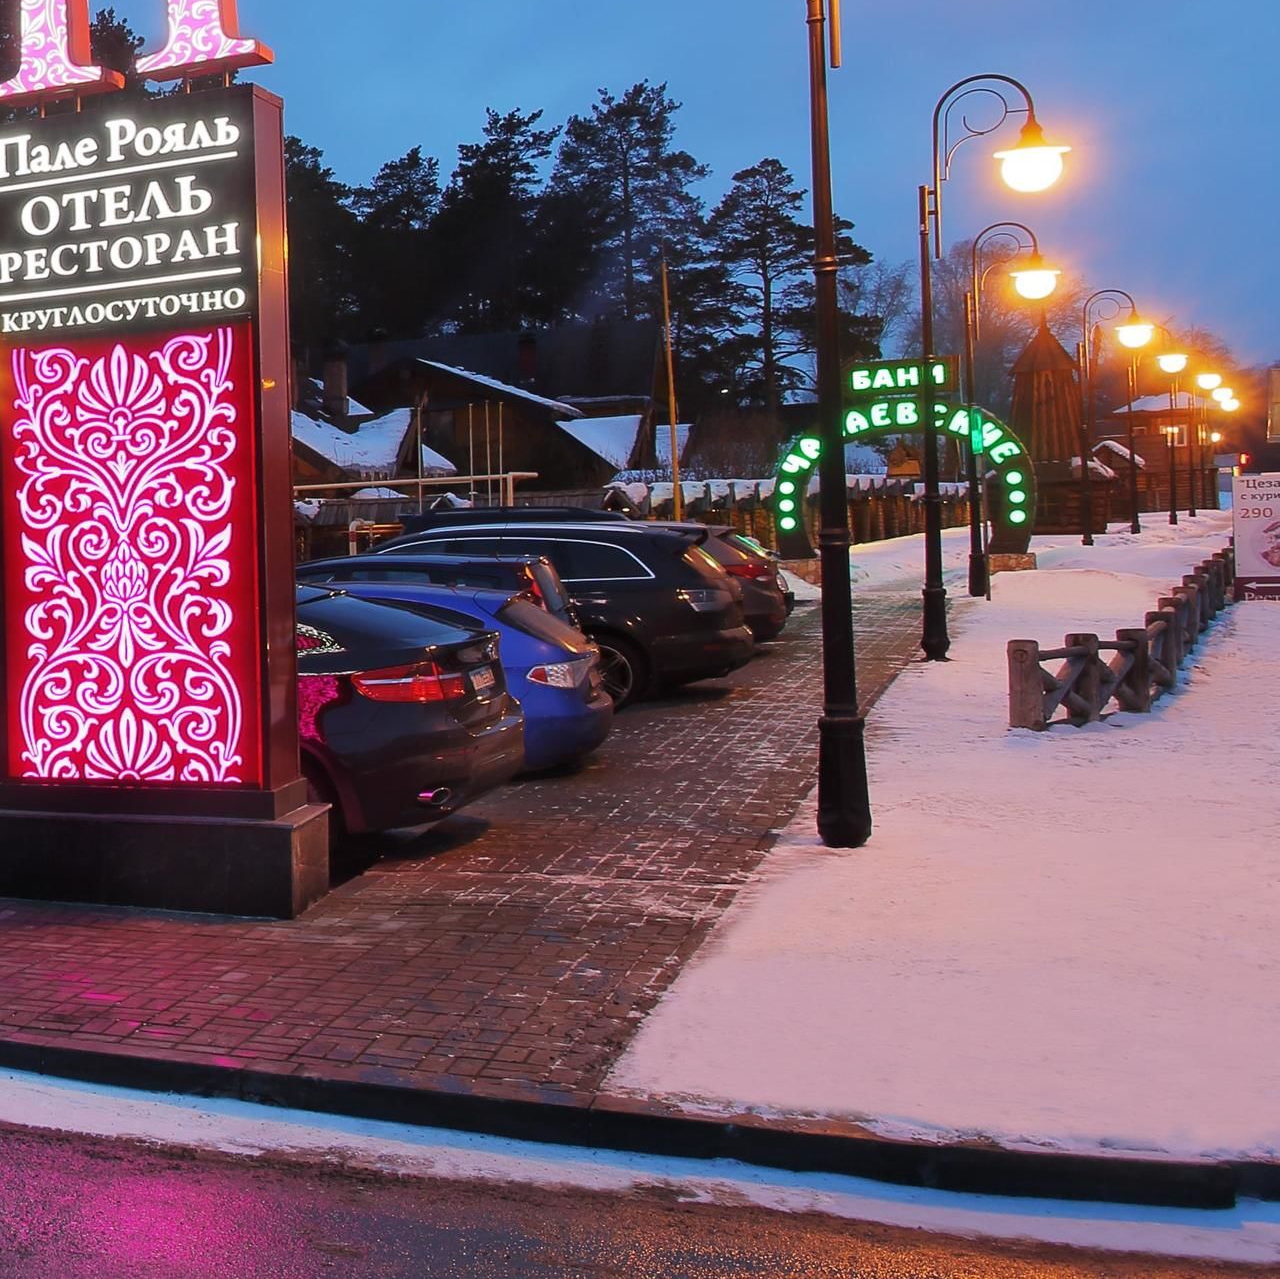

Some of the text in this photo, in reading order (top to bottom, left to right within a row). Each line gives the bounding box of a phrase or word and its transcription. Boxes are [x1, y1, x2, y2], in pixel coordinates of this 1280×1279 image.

[105, 116, 240, 164] Рояль
[20, 174, 213, 238] ОТЕЛЬ
[1, 286, 246, 333] КРУГЛОСУТОЧНО
[1240, 507, 1273, 519] 290
